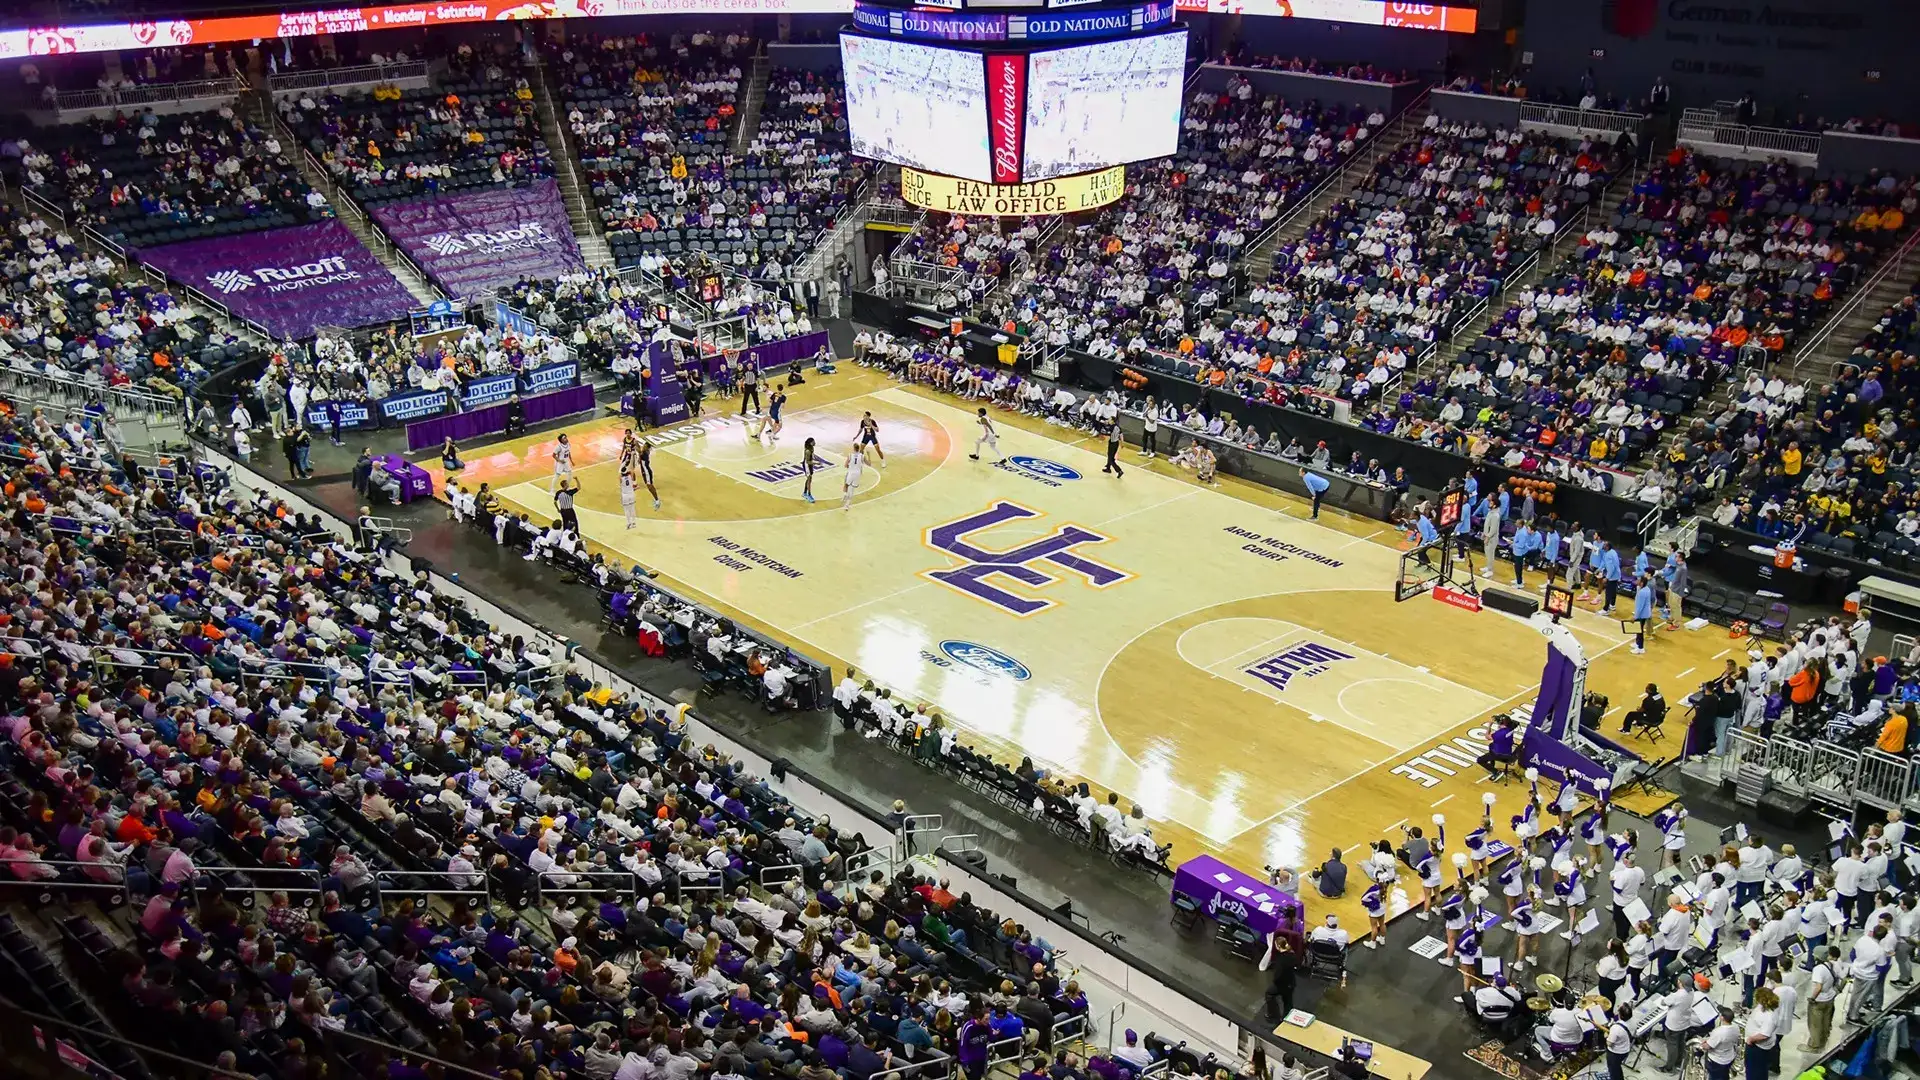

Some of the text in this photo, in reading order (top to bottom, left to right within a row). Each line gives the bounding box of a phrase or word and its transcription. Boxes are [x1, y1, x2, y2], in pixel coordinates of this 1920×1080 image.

[280, 8, 362, 27] Serving Breakfast
[384, 9, 427, 24] Monday
[436, 5, 487, 20] Saturday
[1144, 11, 1161, 24] OLD
[277, 25, 300, 38] 6:30
[301, 24, 317, 36] AM
[326, 21, 351, 34] 10:30
[353, 19, 369, 32] AM
[904, 19, 1004, 34] OLD NATIONAL
[1029, 15, 1130, 33] OLD NATIONAL
[995, 60, 1018, 178] Budweiser
[957, 181, 1056, 198] HATFIELD
[1081, 188, 1109, 207] LAW
[946, 195, 1067, 213] LAW OFFICE
[464, 222, 544, 247] Ruoff
[254, 255, 346, 283] Ruoff
[545, 366, 575, 381] LIGHT
[481, 380, 513, 395] LIGHT
[387, 394, 447, 414] BUD LIGHT
[661, 402, 684, 415] meijer
[311, 413, 327, 421] BU
[1018, 459, 1071, 477] Ford
[1446, 491, 1460, 504] 9:01
[1441, 504, 1458, 525] 21
[1223, 526, 1262, 541] ARAD
[707, 536, 740, 550] ARAD
[1241, 543, 1289, 562] COURT
[713, 554, 753, 572] COURT
[1245, 643, 1357, 691] VALLEY
[1302, 665, 1331, 678] THE
